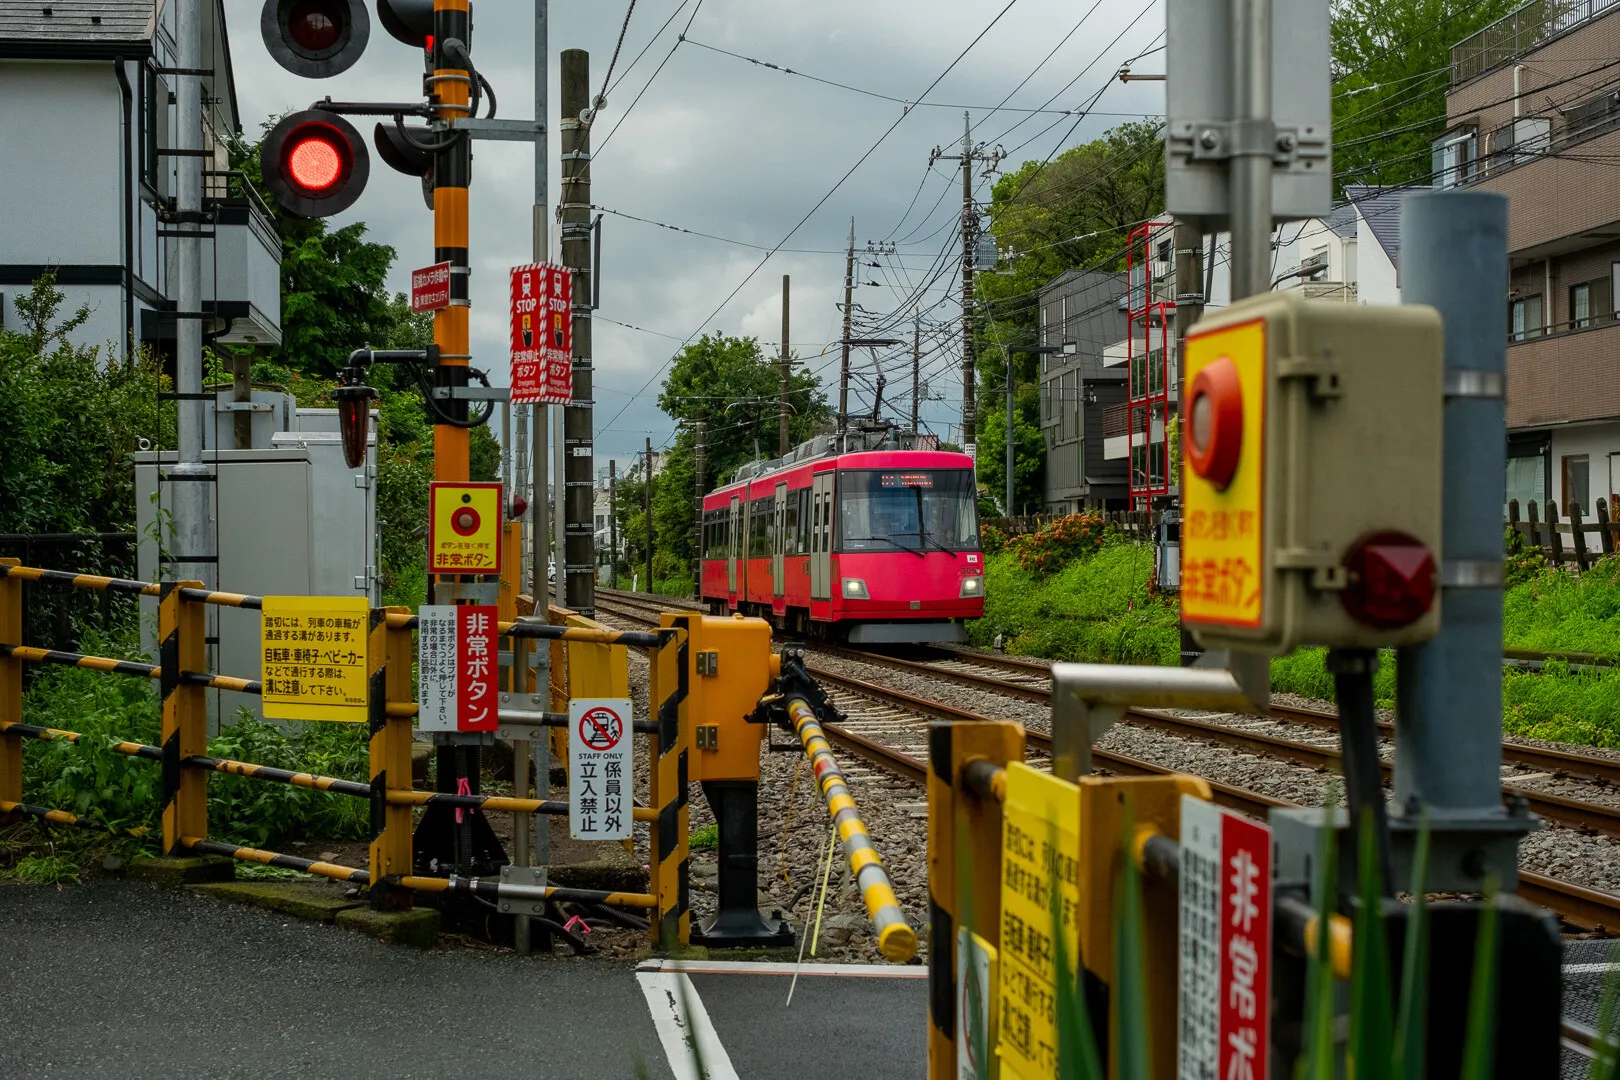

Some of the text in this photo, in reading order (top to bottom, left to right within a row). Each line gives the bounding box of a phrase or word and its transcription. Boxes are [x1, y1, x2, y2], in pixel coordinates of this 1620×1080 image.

[516, 298, 536, 313] STOP
[549, 297, 567, 313] STOP
[513, 350, 540, 364] 非常停止
[546, 349, 570, 364] 非常停止
[516, 365, 536, 378] ボタン
[549, 364, 567, 377] ボタン
[440, 541, 489, 550] ボタンを強く押す
[436, 552, 493, 567] 非常ボタン
[265, 616, 360, 629] 踏切には、列車の車輪が
[265, 630, 354, 642] 通過する溝があります。
[420, 619, 429, 710] 使用すると処罰されます。
[447, 619, 456, 697] 非常ボタンはブザーが
[265, 666, 346, 679] などで通行する際は、
[438, 619, 447, 725] なるまでつよく押して下さい。
[466, 613, 489, 723] 非常ボタン
[265, 679, 346, 696] 溝に注意して下さい。
[578, 752, 623, 760] STAFF ONLY
[580, 761, 598, 833] 立入禁止
[604, 761, 622, 833] 係員以外
